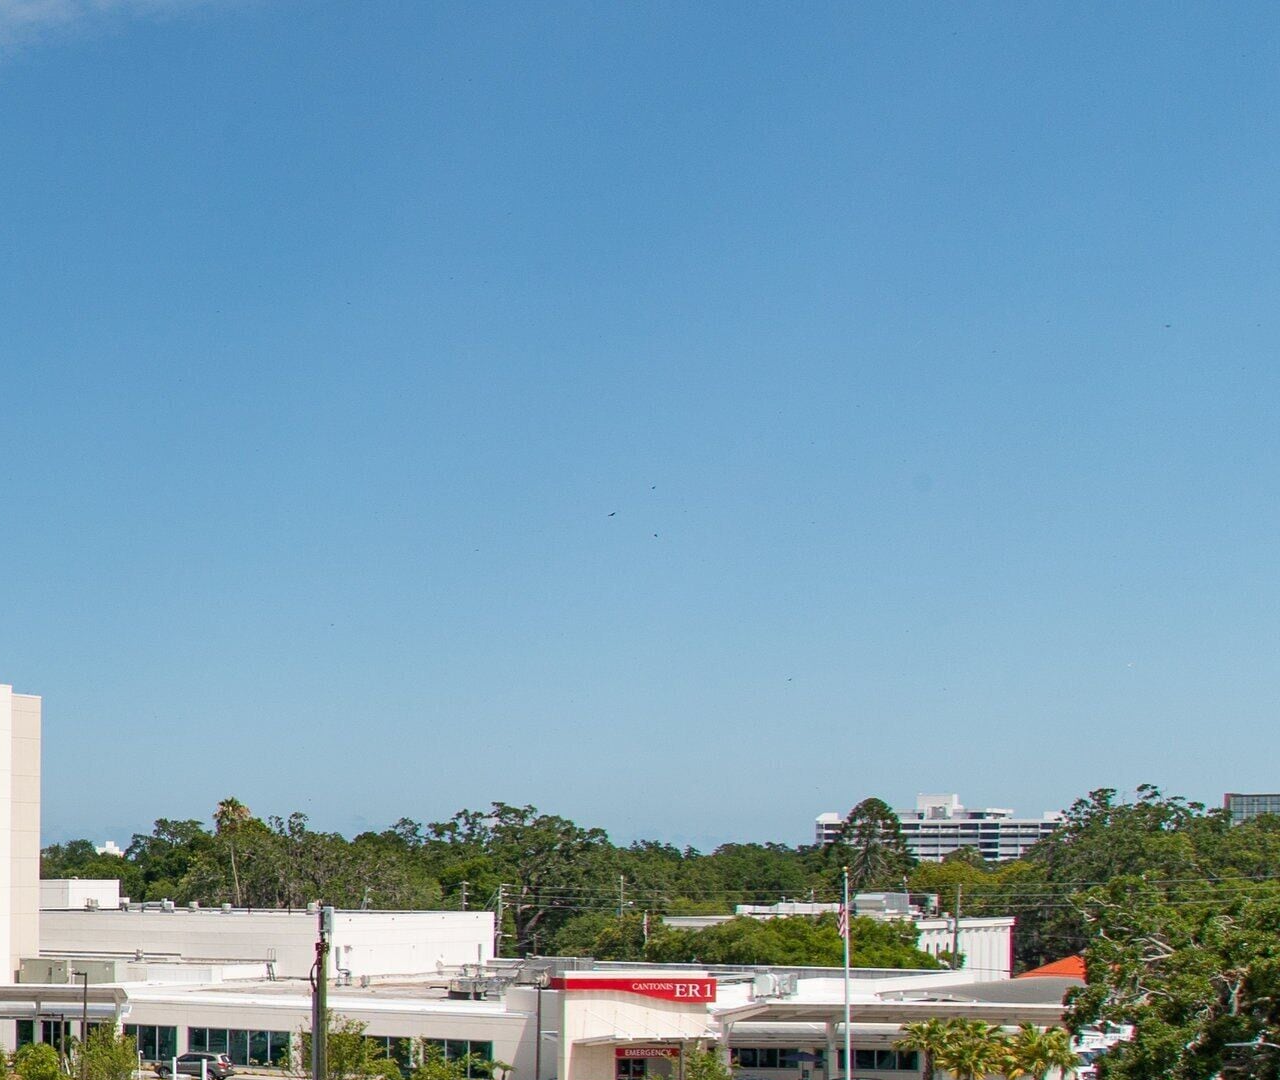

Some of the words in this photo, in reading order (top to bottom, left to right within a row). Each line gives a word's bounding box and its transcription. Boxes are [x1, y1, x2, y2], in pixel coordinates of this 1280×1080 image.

[632, 982, 674, 991] CANTONIS
[674, 983, 702, 998] ER
[704, 983, 713, 998] 1
[624, 1049, 672, 1057] EMERGENCY
